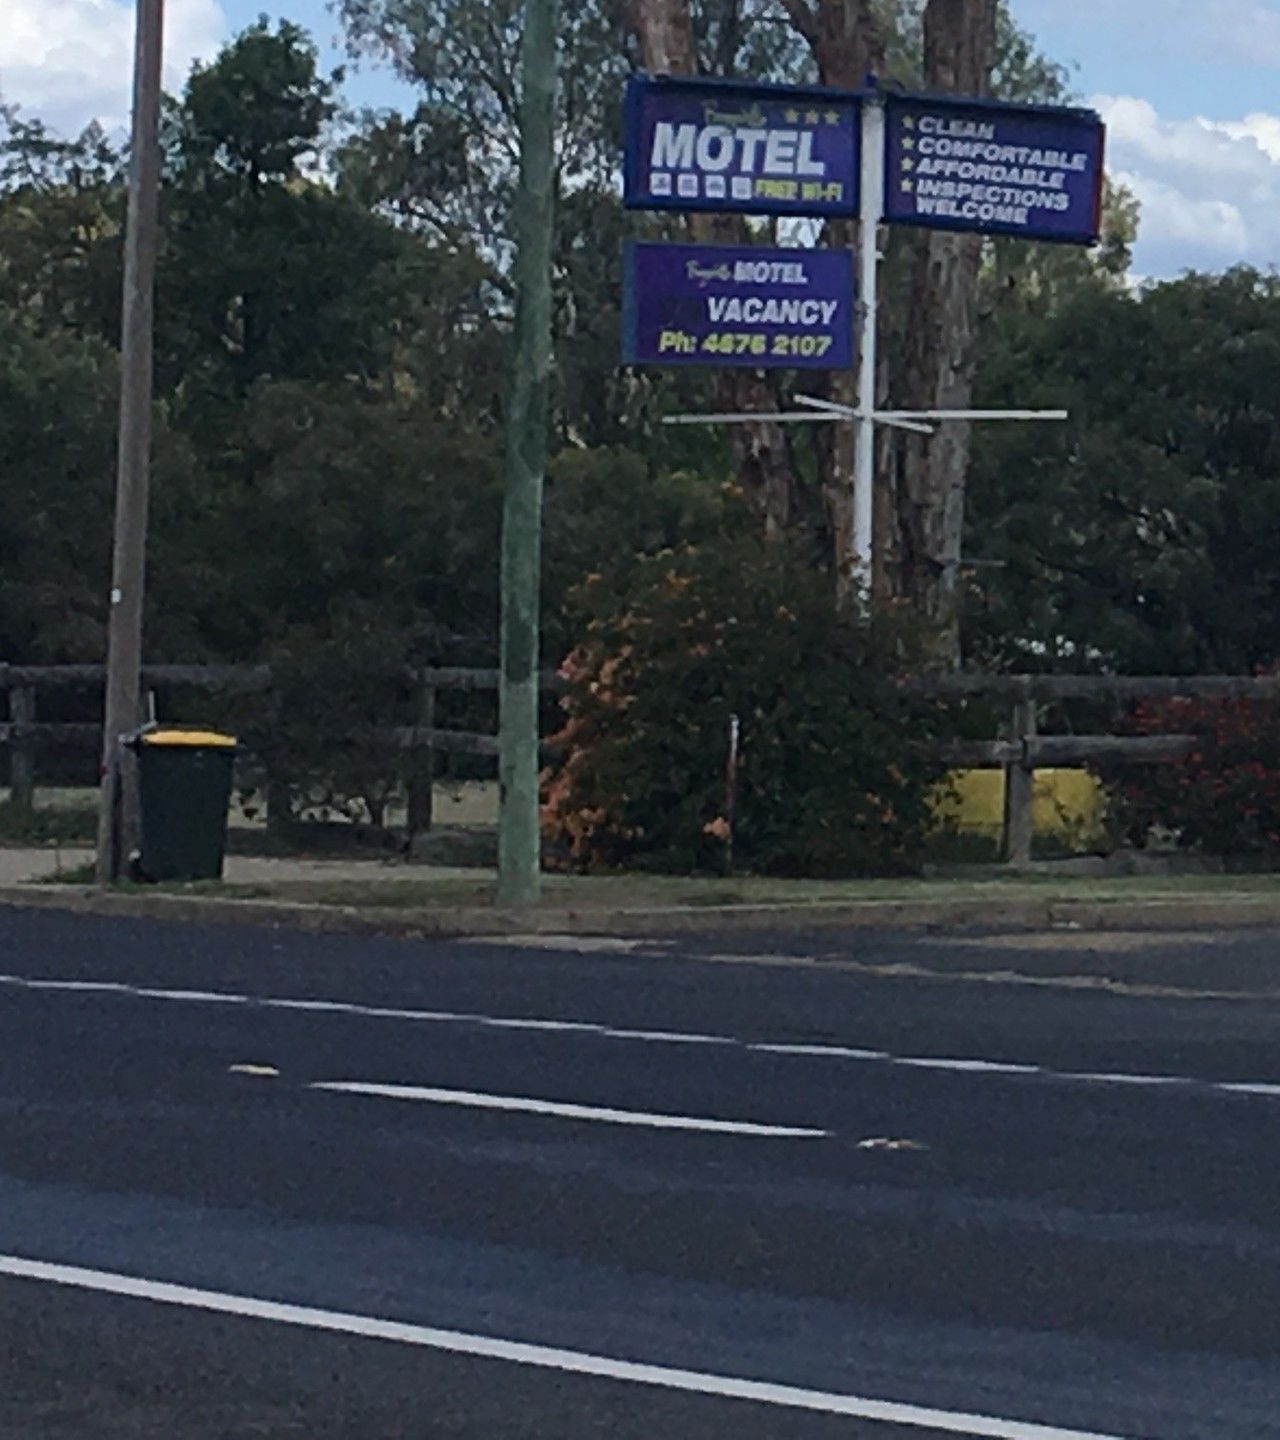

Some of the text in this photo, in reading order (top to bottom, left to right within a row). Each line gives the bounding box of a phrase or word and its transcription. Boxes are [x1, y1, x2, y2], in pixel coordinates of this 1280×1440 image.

[918, 116, 995, 140] CLEAN
[651, 121, 825, 176] MOTEL
[918, 137, 1087, 171] COMFORTABLE
[916, 157, 1066, 189] AFFORDABLE
[917, 179, 1070, 211] INSPECTIONS
[917, 196, 1029, 224] WELCOME
[733, 260, 809, 284] MOTEL
[707, 296, 837, 325] VACANCY
[658, 328, 697, 353] Ph:
[771, 334, 833, 357] 2107
